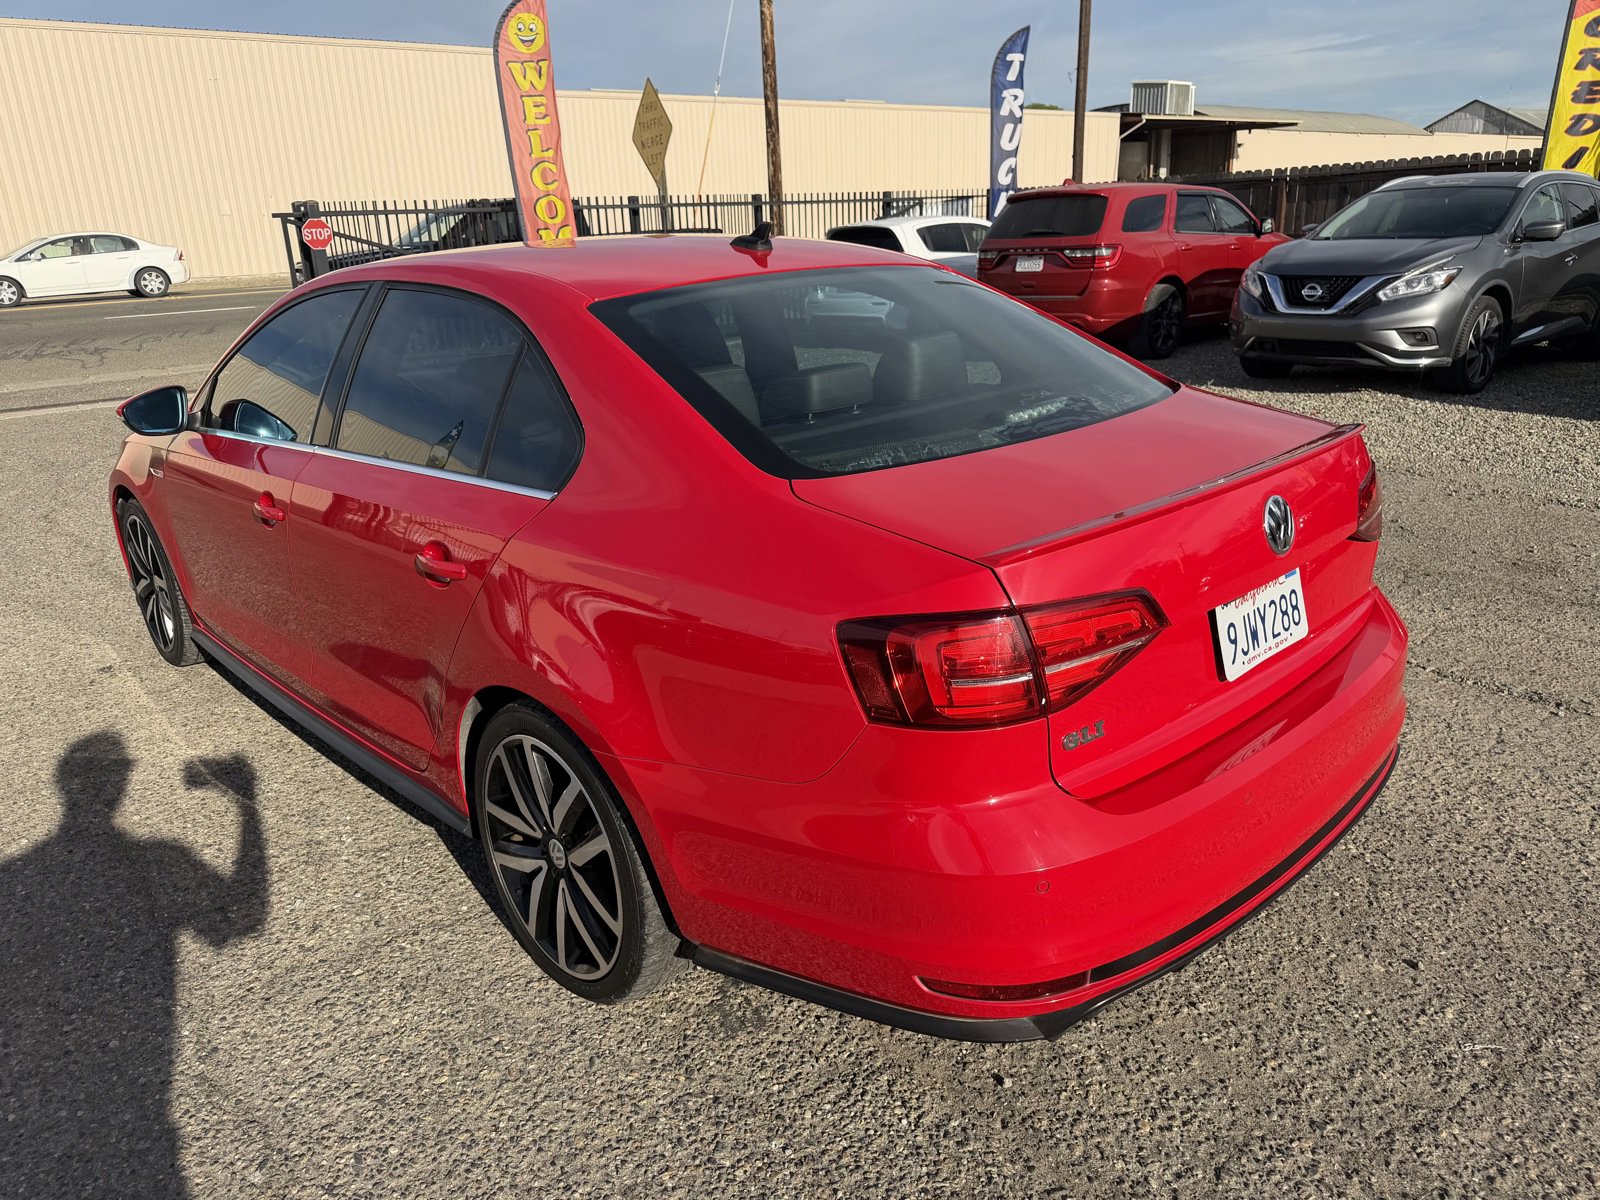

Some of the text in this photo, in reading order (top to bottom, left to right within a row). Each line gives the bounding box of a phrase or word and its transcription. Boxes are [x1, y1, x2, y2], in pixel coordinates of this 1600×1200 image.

[641, 100, 658, 114] THRU
[638, 115, 663, 133] TRAFFIC
[640, 133, 663, 149] MERGE
[647, 152, 662, 166] LEFT
[304, 228, 331, 240] STOP
[1227, 588, 1301, 666] 9JWY288
[1246, 637, 1289, 664] dmv.ca.gov
[1062, 720, 1105, 751] GLI
